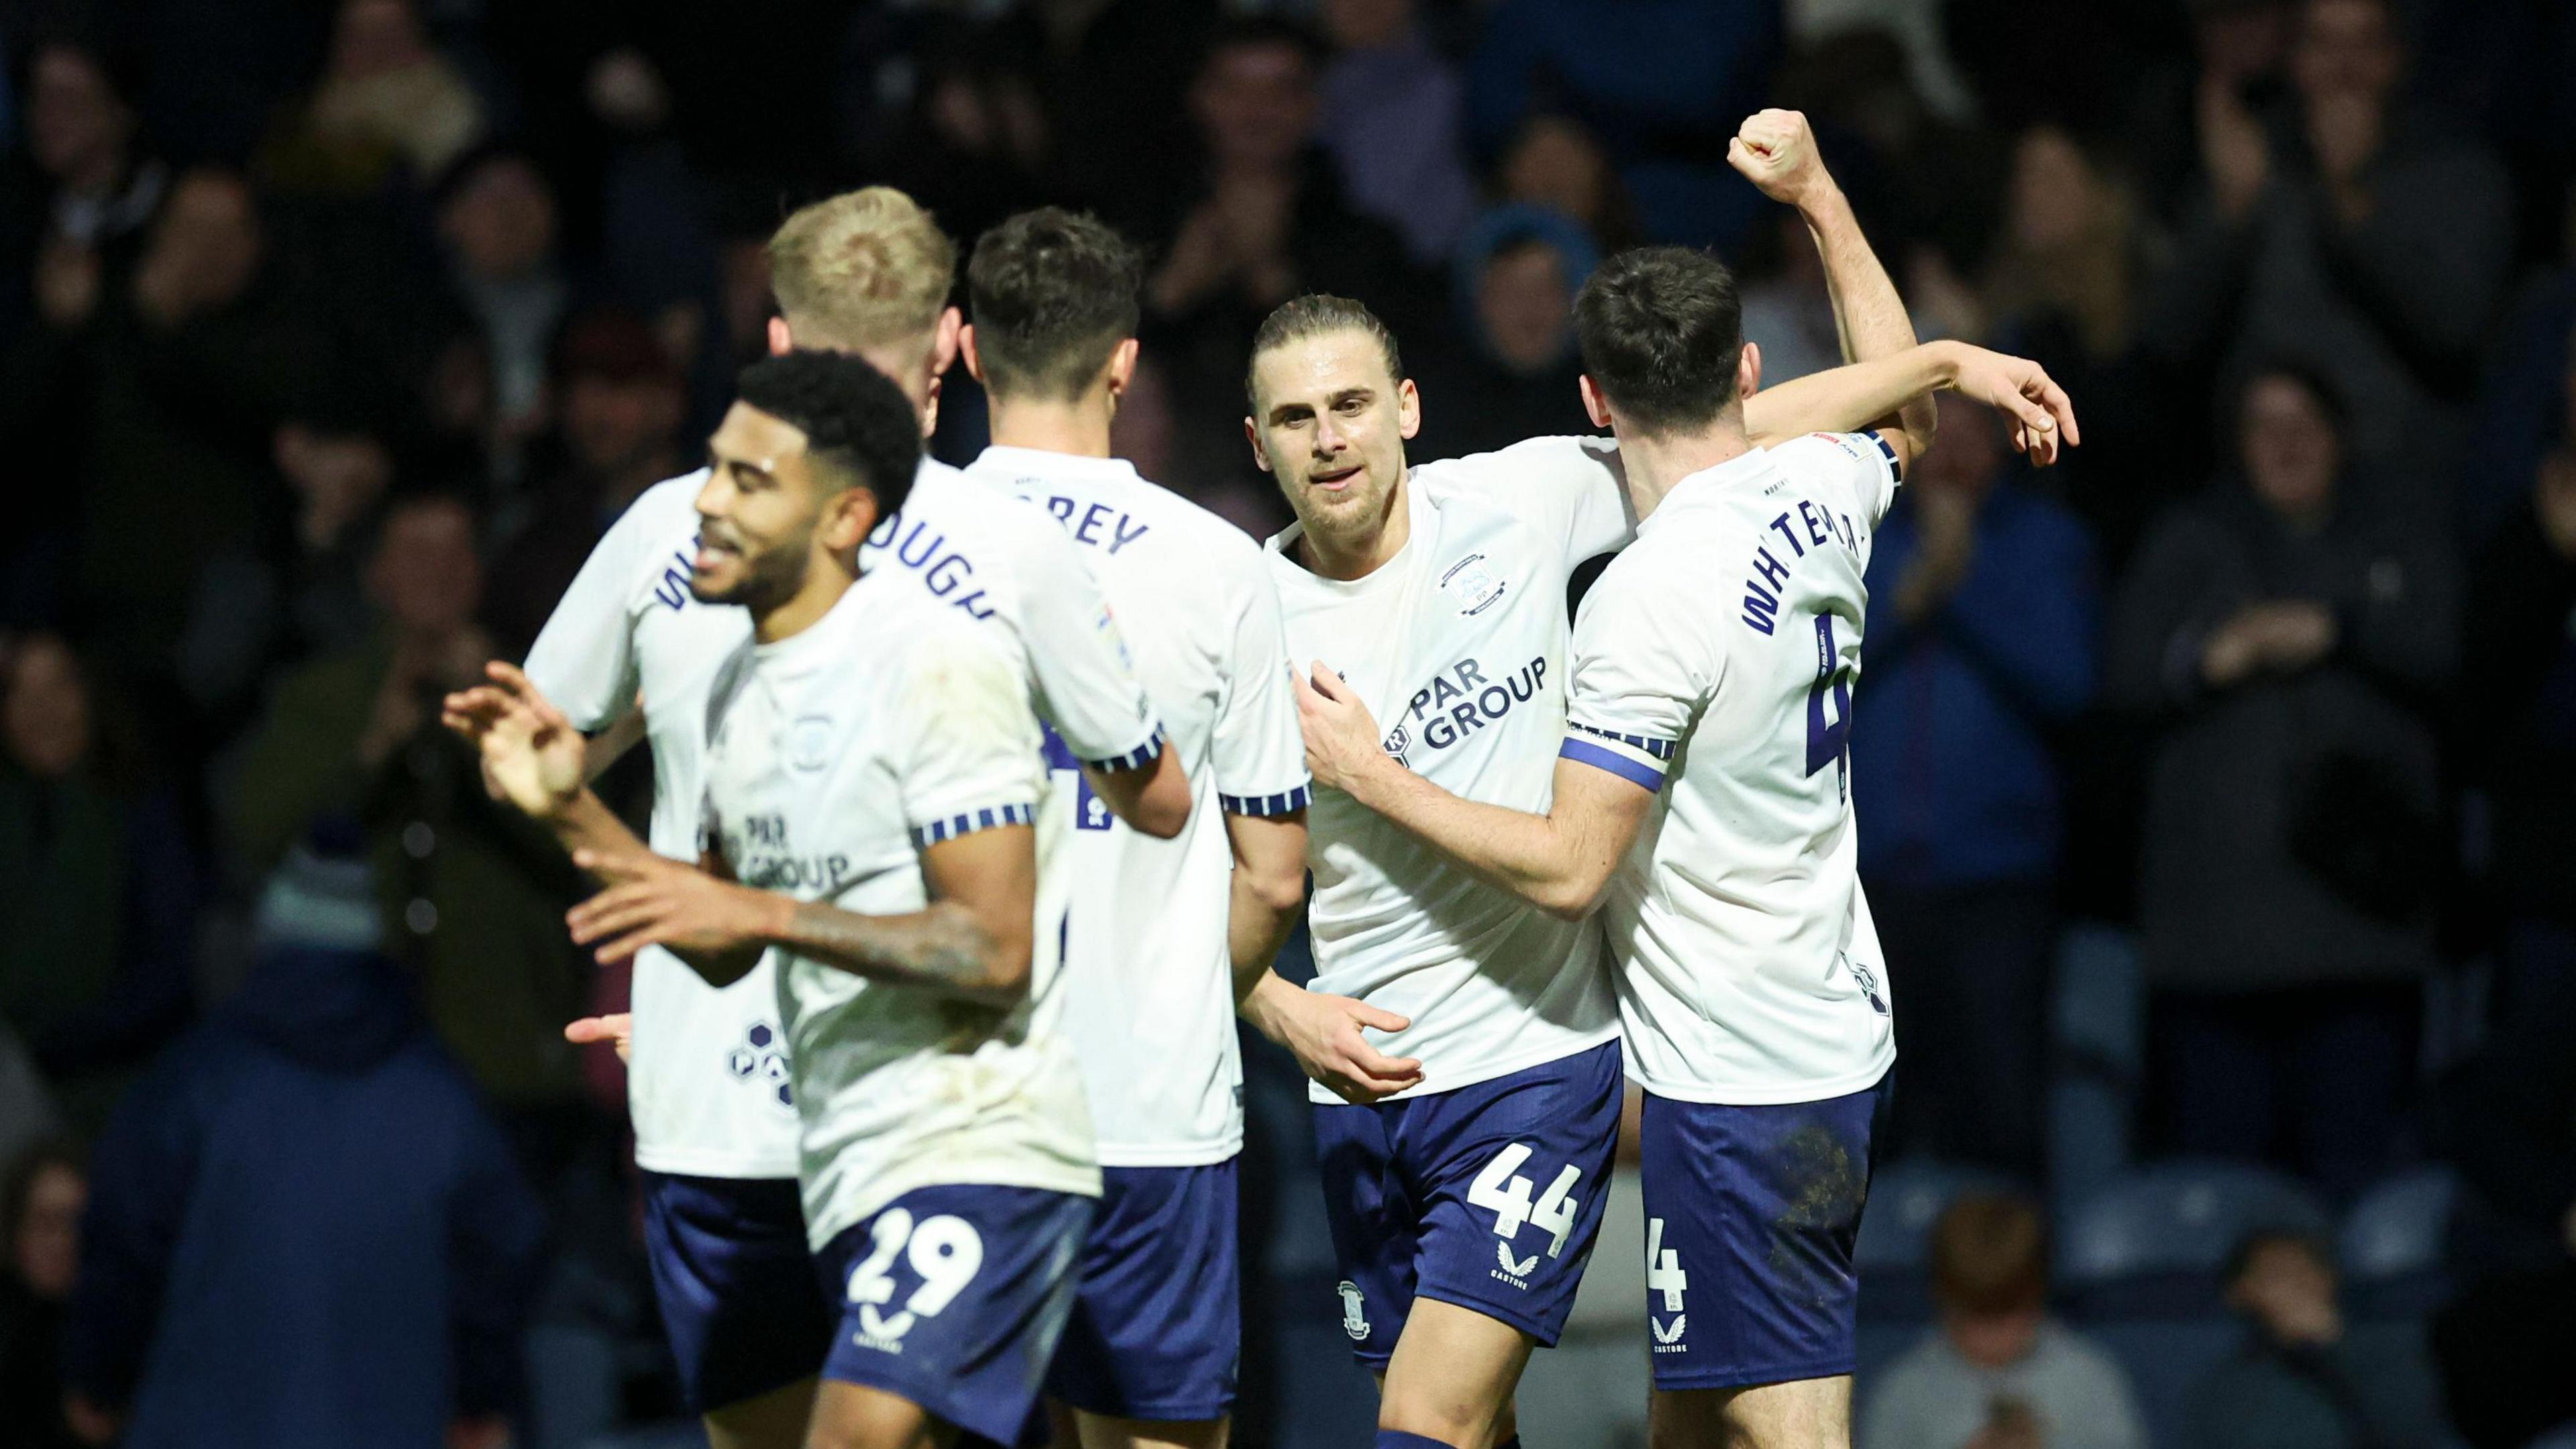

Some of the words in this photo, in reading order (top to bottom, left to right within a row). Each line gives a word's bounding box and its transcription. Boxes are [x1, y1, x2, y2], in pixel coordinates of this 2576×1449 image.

[1410, 658, 1488, 722] PAR
[1424, 656, 1546, 750] GROUP
[1806, 608, 1850, 806] 4
[1467, 1142, 1581, 1259] 44
[847, 1207, 984, 1318] 29
[1491, 1269, 1527, 1291] CASTORE
[1648, 1218, 1687, 1311] 4
[1654, 1344, 1687, 1353] CASTORE
